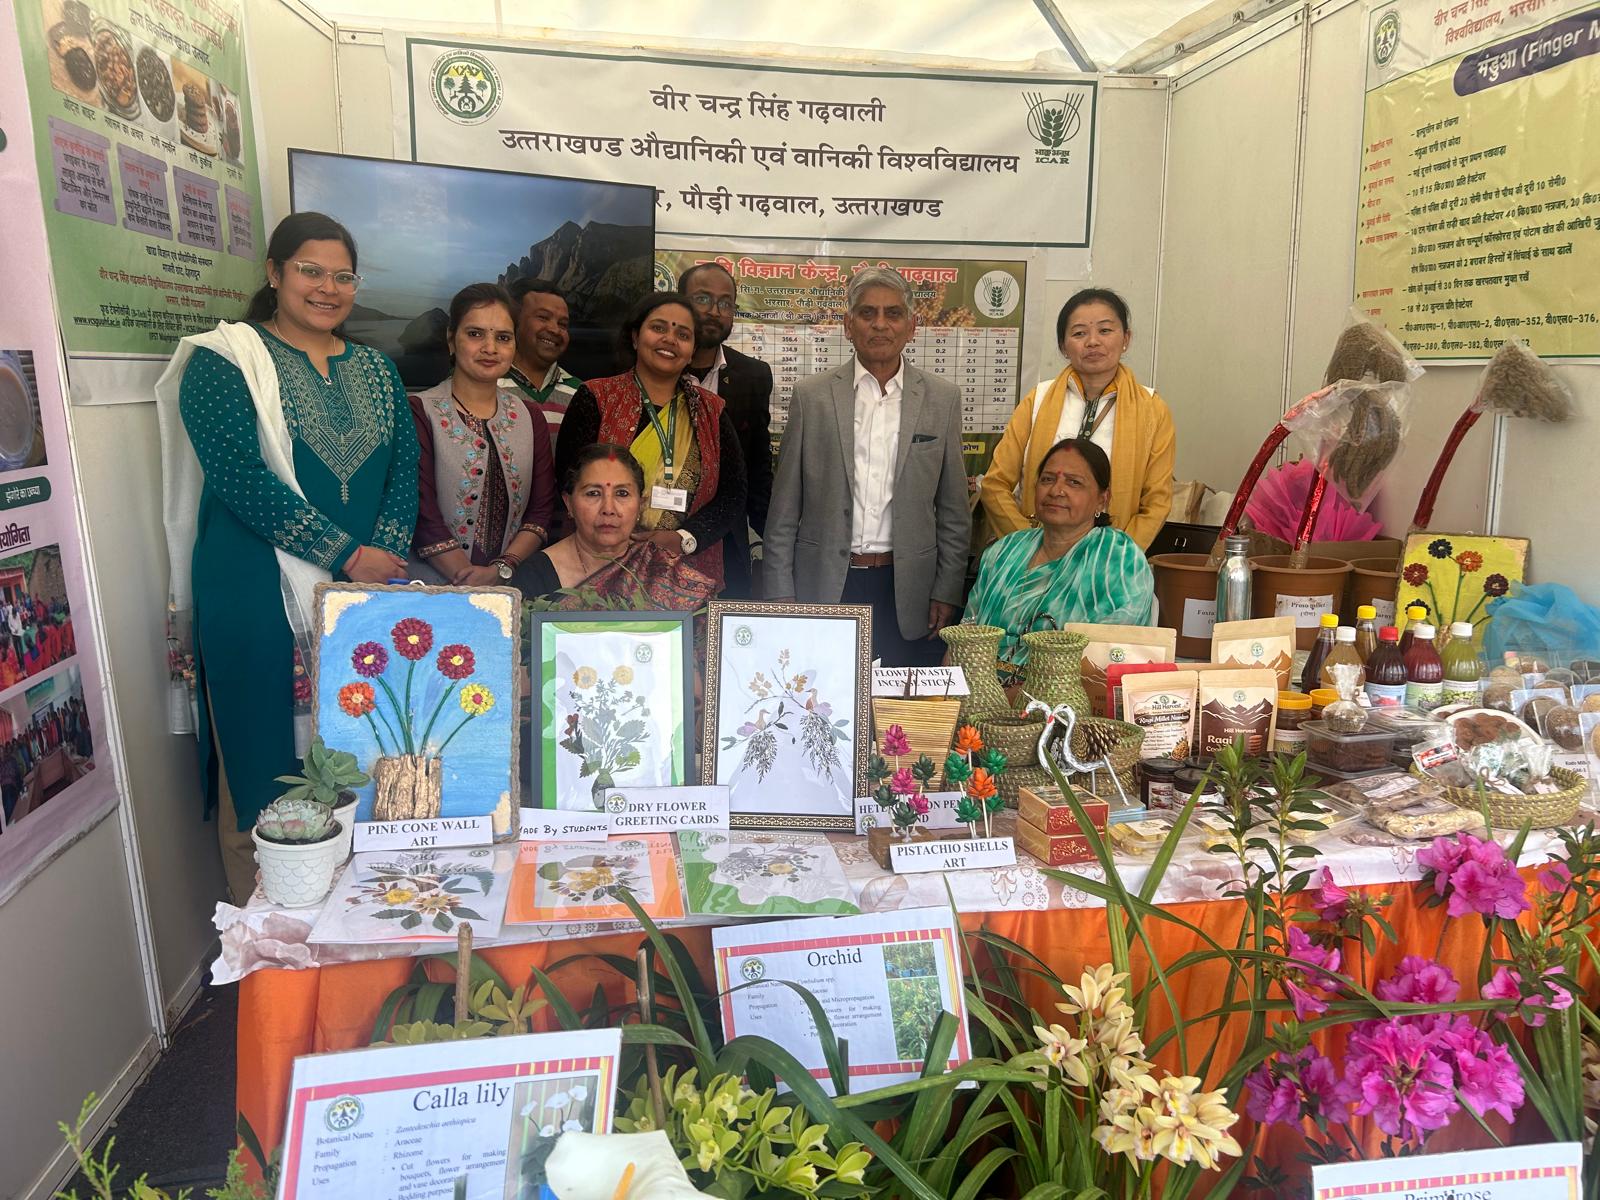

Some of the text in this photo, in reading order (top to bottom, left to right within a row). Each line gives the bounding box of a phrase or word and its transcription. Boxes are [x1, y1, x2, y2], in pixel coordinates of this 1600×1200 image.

[1434, 9, 1448, 26] वीर
[1478, 48, 1518, 82] मंडुआ
[1522, 28, 1584, 68] (Finger
[650, 84, 886, 124] वीर चन्द्र सिंह गढ़वाली
[499, 130, 1020, 174] उत्तराखण्ड औद्यानिकी एवं वानिकी विश्वविद्यालय
[1536, 181, 1545, 190] 10
[680, 184, 732, 214] पौड़ी
[736, 194, 824, 217] गढ़वाल,
[832, 197, 944, 217] उत्तराखण्ड
[738, 257, 796, 280] विज्ञान
[798, 258, 848, 283] केन्द्र,
[896, 266, 958, 284] गढ़वाल
[1444, 282, 1452, 290] 30
[0, 522, 30, 549] योगिता
[875, 669, 916, 677] FLOWER
[1207, 735, 1232, 746] Ragi
[628, 802, 707, 813] DRY FLOWER
[368, 820, 480, 835] PINE CONE WALL
[615, 815, 719, 826] GREETING CARDS
[544, 825, 558, 836] By
[562, 824, 608, 833] STUDENTS
[410, 836, 438, 847] ART
[897, 841, 1009, 857] PISTACHIO SHELLS
[943, 858, 967, 868] ART
[808, 948, 862, 967] Orchid
[832, 995, 874, 1003] Micropropagation
[413, 1082, 511, 1111] Calla lily
[316, 1133, 351, 1146] Botanical
[352, 1131, 374, 1140] Name
[315, 1137, 422, 1159] Family Araceae
[314, 1149, 424, 1172] Propagation Rhizome
[401, 1163, 414, 1171] Cut
[426, 1158, 450, 1167] flowers
[483, 1148, 506, 1158] making
[439, 1165, 460, 1174] flower
[466, 1159, 506, 1170] arrangement
[399, 1183, 412, 1192] and
